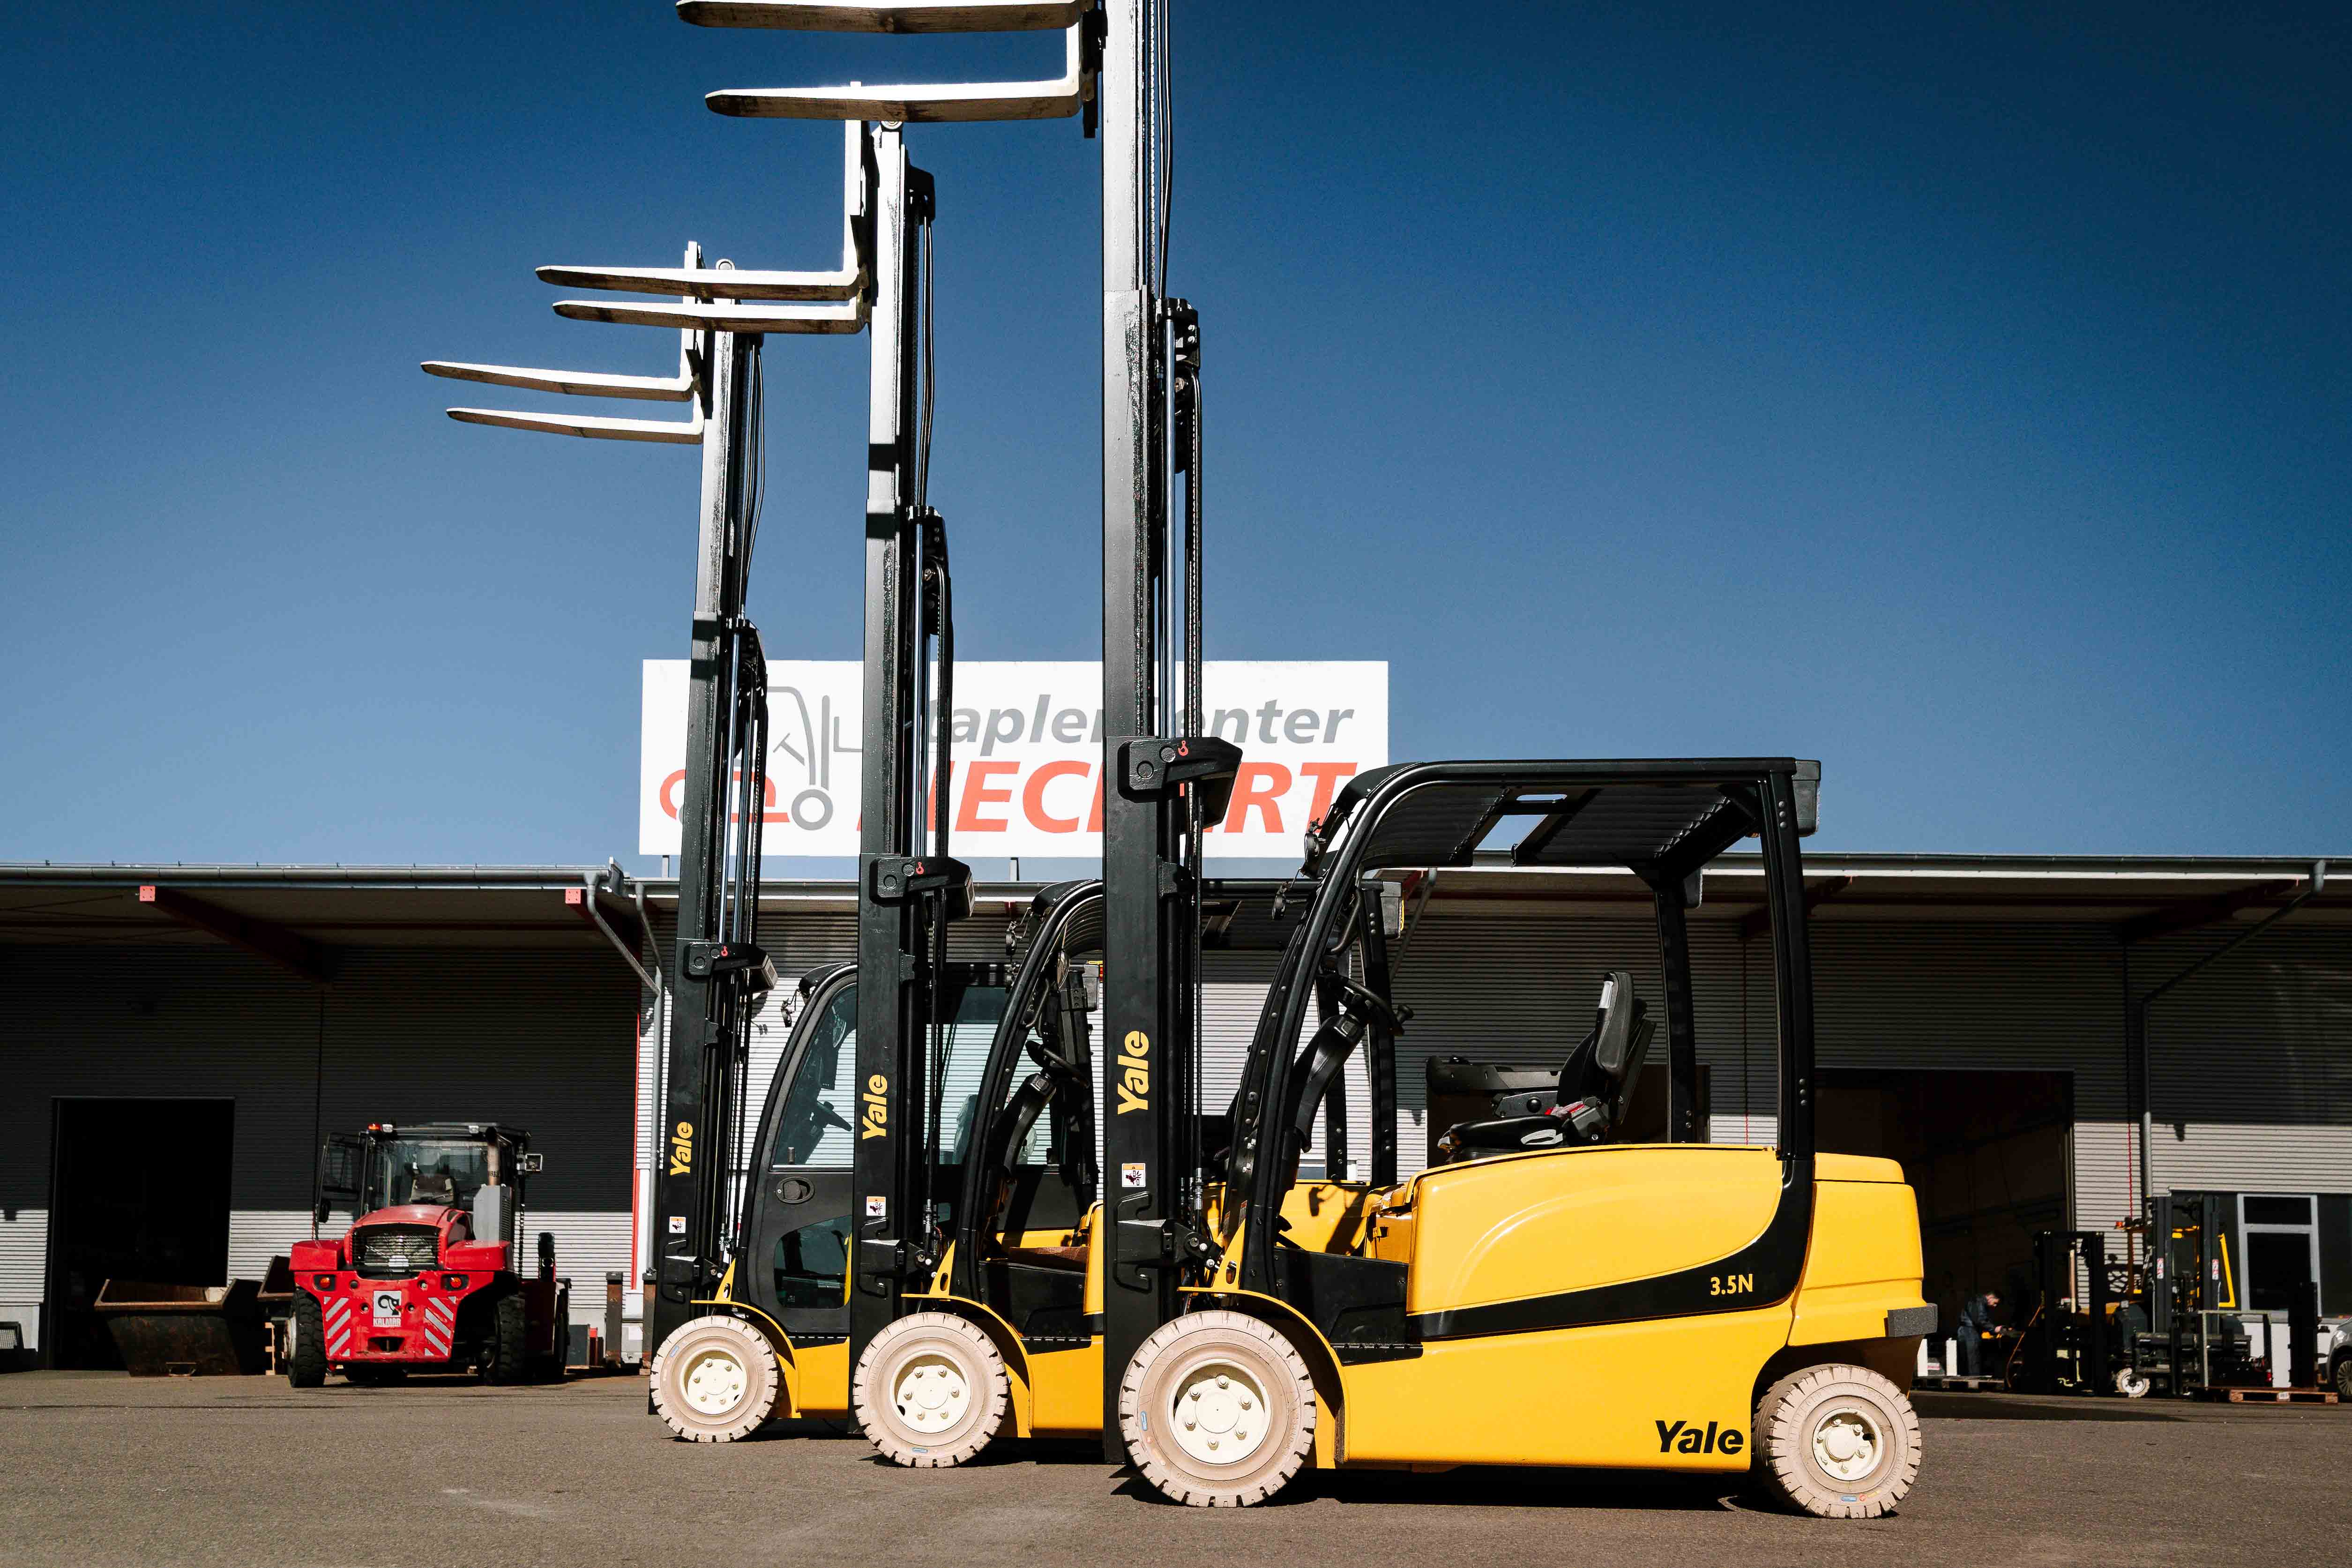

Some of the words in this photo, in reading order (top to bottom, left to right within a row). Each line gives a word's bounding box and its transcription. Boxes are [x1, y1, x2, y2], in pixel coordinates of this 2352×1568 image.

[1117, 1030, 1149, 1115] Yale
[862, 1074, 888, 1140] Yale
[670, 1121, 693, 1176] Yale
[1710, 1274, 1753, 1296] 3.5N
[1655, 1420, 1744, 1455] Yale
